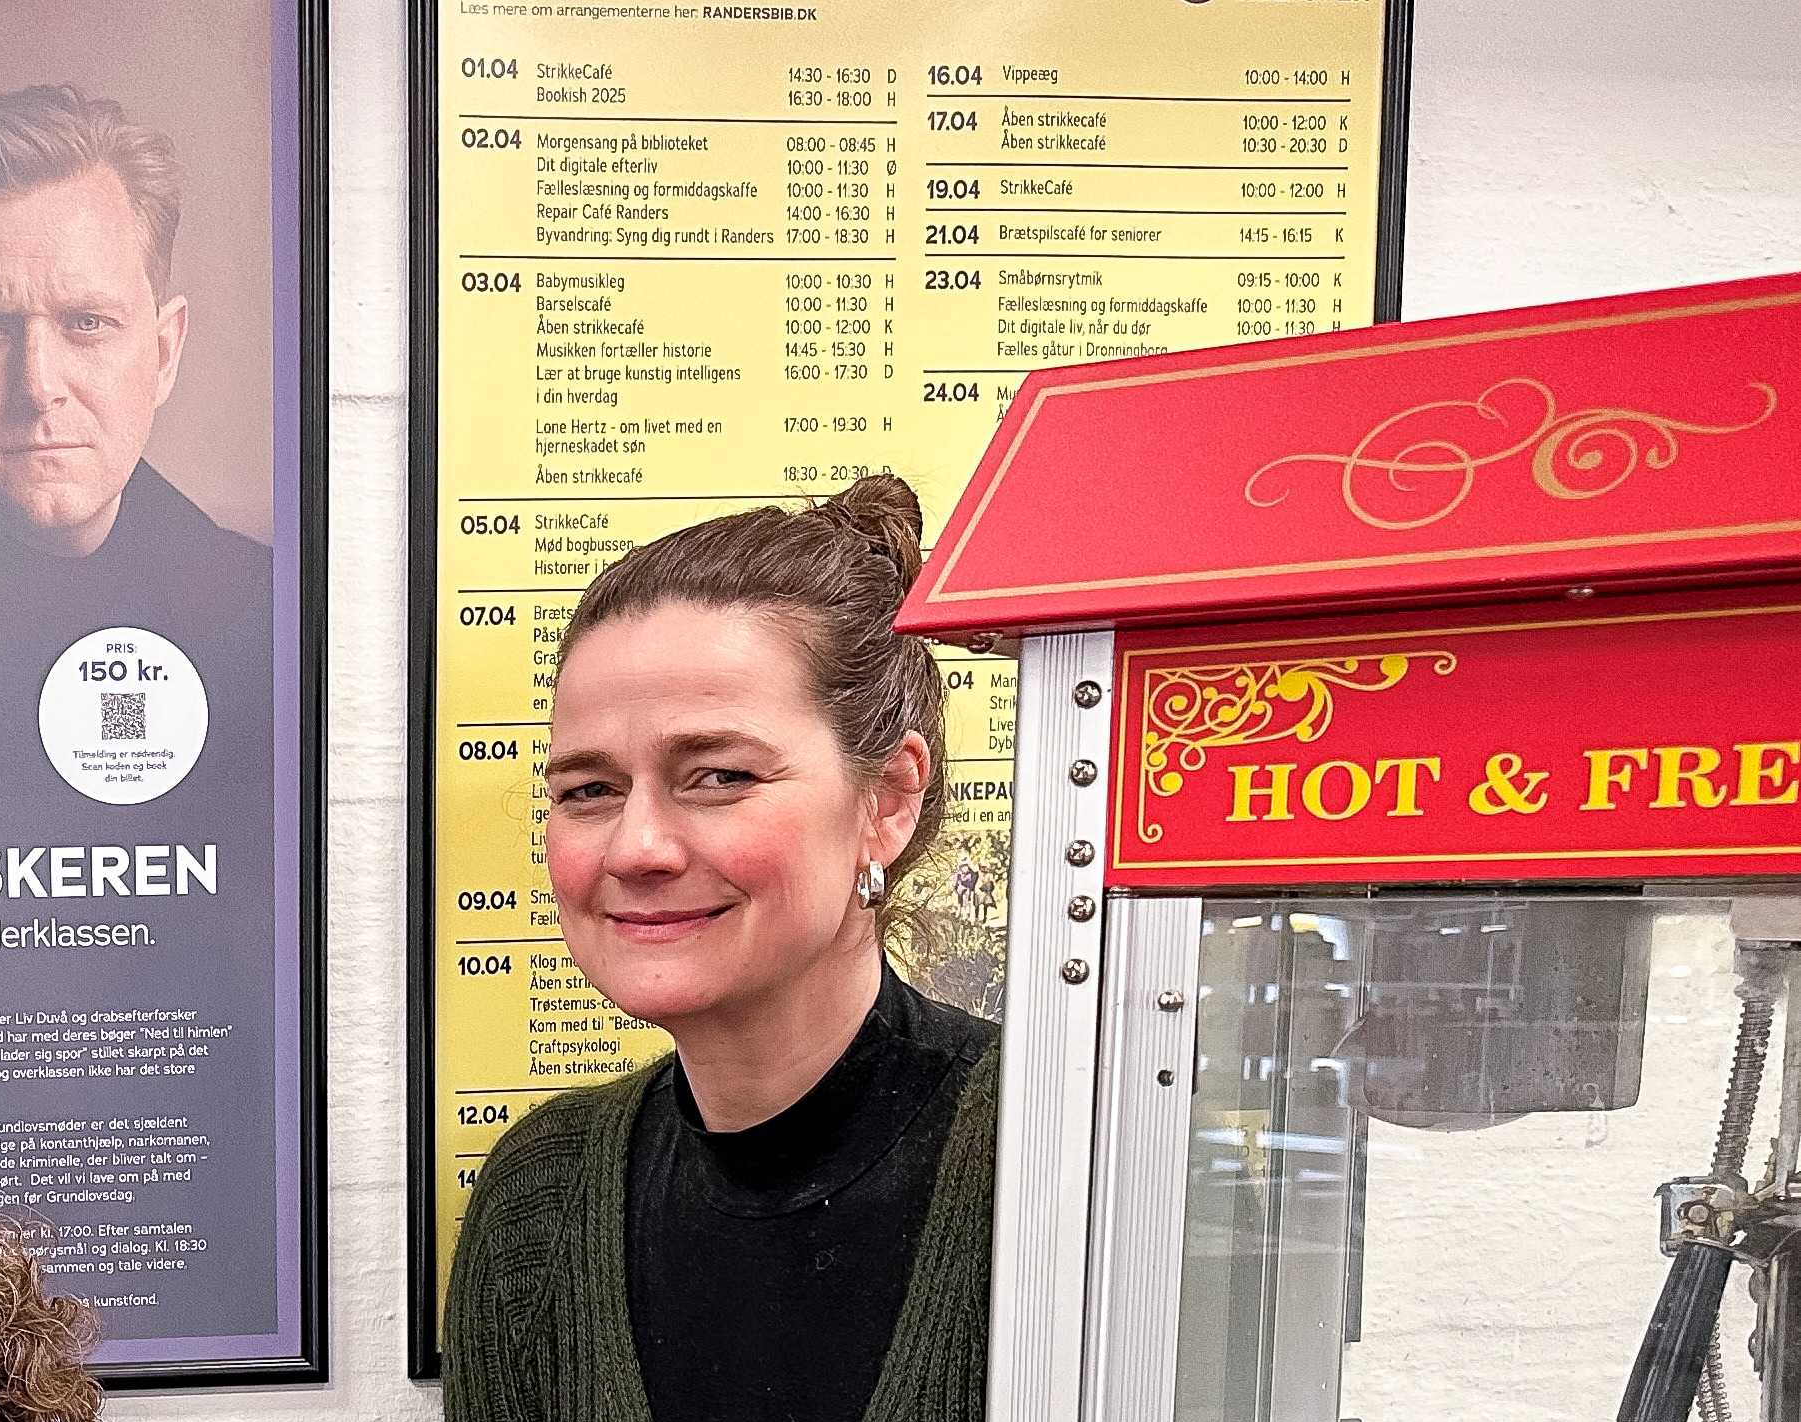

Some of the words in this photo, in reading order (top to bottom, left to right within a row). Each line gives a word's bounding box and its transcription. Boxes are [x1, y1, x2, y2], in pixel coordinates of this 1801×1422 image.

[492, 3, 527, 17] mere
[530, 5, 553, 18] om
[556, 4, 671, 21] arrangementerne
[673, 4, 698, 19] her:
[702, 6, 818, 21] RANDERSBIB.DK
[461, 57, 519, 80] 01.04
[536, 62, 613, 80] StrikkeCafé
[788, 67, 823, 83] 14:30
[836, 67, 871, 84] 16:30
[887, 68, 897, 84] D
[927, 65, 983, 86] 16.04
[1002, 64, 1058, 85] Vippeæg
[536, 86, 587, 103] Bookish
[591, 87, 626, 104] 2025
[927, 110, 978, 132] 17.04
[1001, 105, 1034, 128] Åben
[1037, 111, 1107, 128] strikkecafé
[461, 127, 522, 150] 02.04
[537, 133, 618, 154] Morgensang
[621, 133, 638, 154] på
[641, 134, 709, 151] biblioteket
[537, 156, 556, 172] Dit
[559, 156, 608, 177] digitale
[611, 157, 658, 174] efterliv
[925, 224, 980, 245] 21.04
[999, 224, 1086, 244] Brætspilscafé
[1089, 225, 1108, 241] for
[1111, 227, 1162, 242] seniorer
[461, 272, 522, 293] 03.04
[536, 272, 625, 293] Babymusikleg
[536, 295, 612, 312] Barselscafé
[460, 514, 521, 536] 05.04
[534, 512, 609, 530] StrikkeCafé
[459, 605, 517, 626] 07.04
[105, 642, 138, 655] PRIS:
[78, 660, 128, 682] 150
[137, 658, 169, 682] kr.
[1225, 756, 1442, 823] HOT
[1468, 751, 1550, 817] &
[457, 955, 512, 976] 10.04
[15, 1012, 34, 1025] Liv
[36, 1009, 69, 1025] Duvå
[71, 1013, 87, 1026] og
[90, 1008, 198, 1023] drabsefterforsker
[529, 1037, 621, 1059] Craftpsykologi
[108, 1117, 130, 1130] det
[133, 1116, 188, 1132] sjældent
